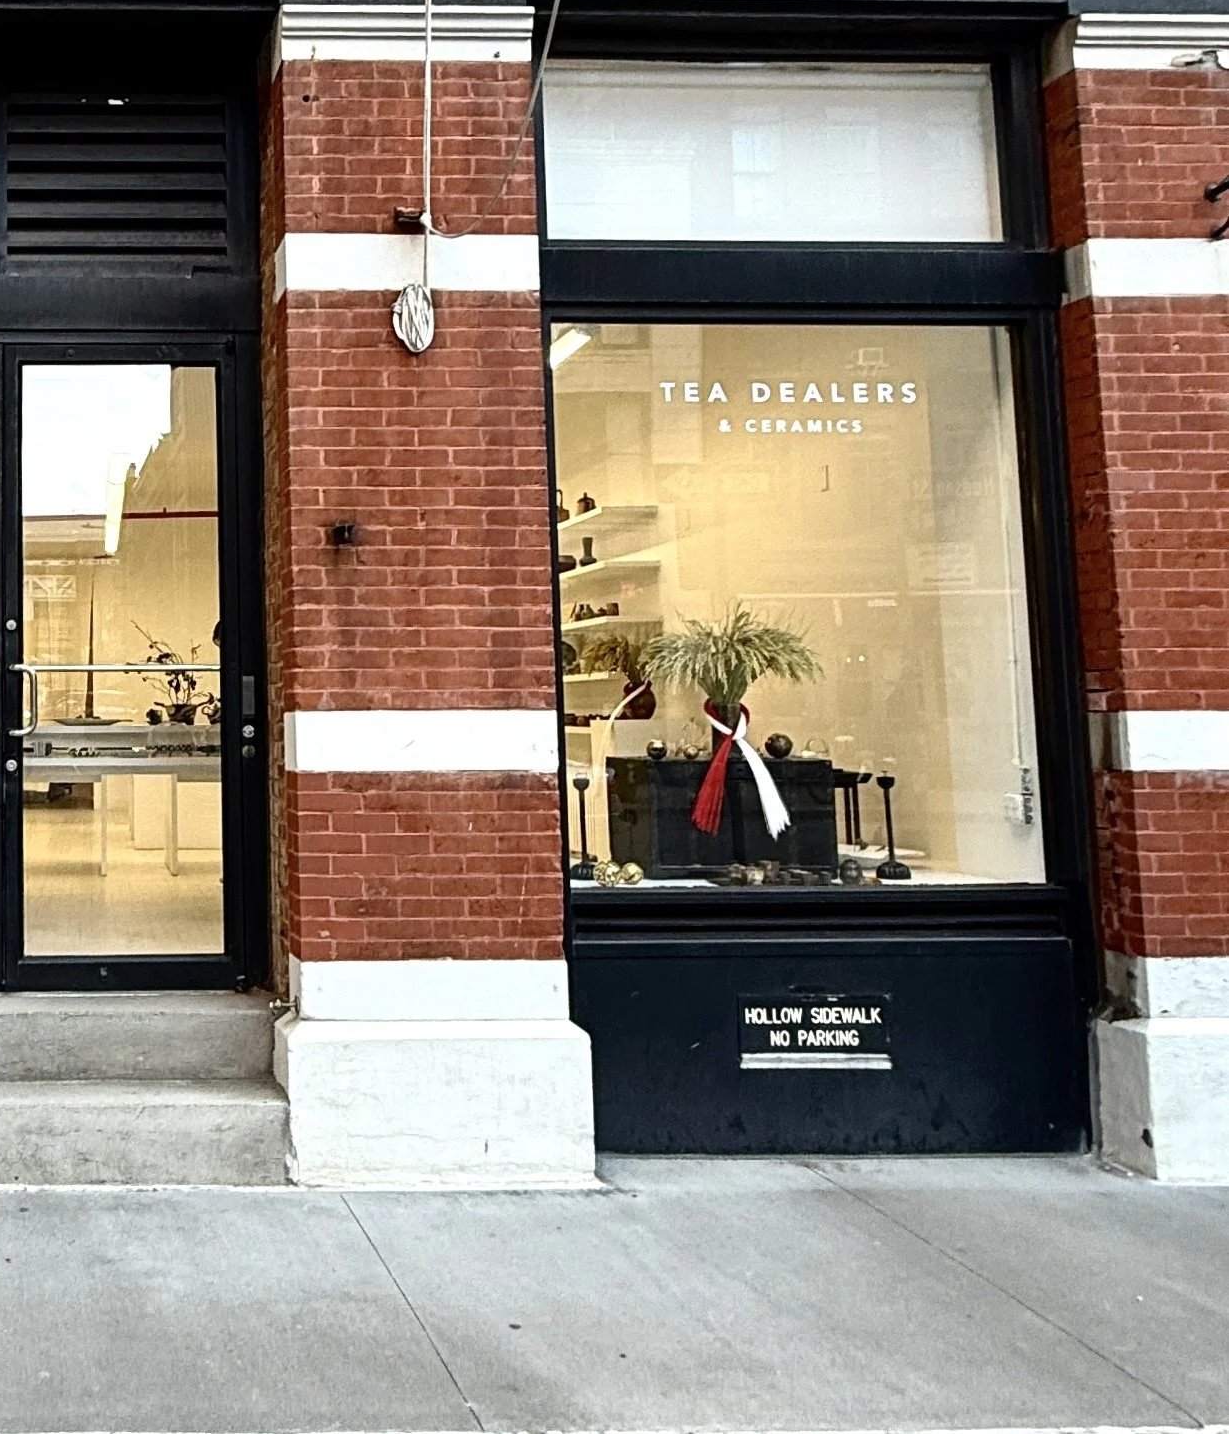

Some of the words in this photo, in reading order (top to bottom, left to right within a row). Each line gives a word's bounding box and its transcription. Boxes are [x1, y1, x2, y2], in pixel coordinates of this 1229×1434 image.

[659, 382, 728, 404] TEA
[750, 381, 918, 404] DEALERS
[718, 419, 732, 433] &
[745, 418, 863, 434] CERAMICS
[744, 1007, 803, 1025] HOLLOW
[810, 1006, 883, 1025] SIDEWALK
[769, 1029, 791, 1047] NO
[797, 1029, 861, 1047] PARKING
